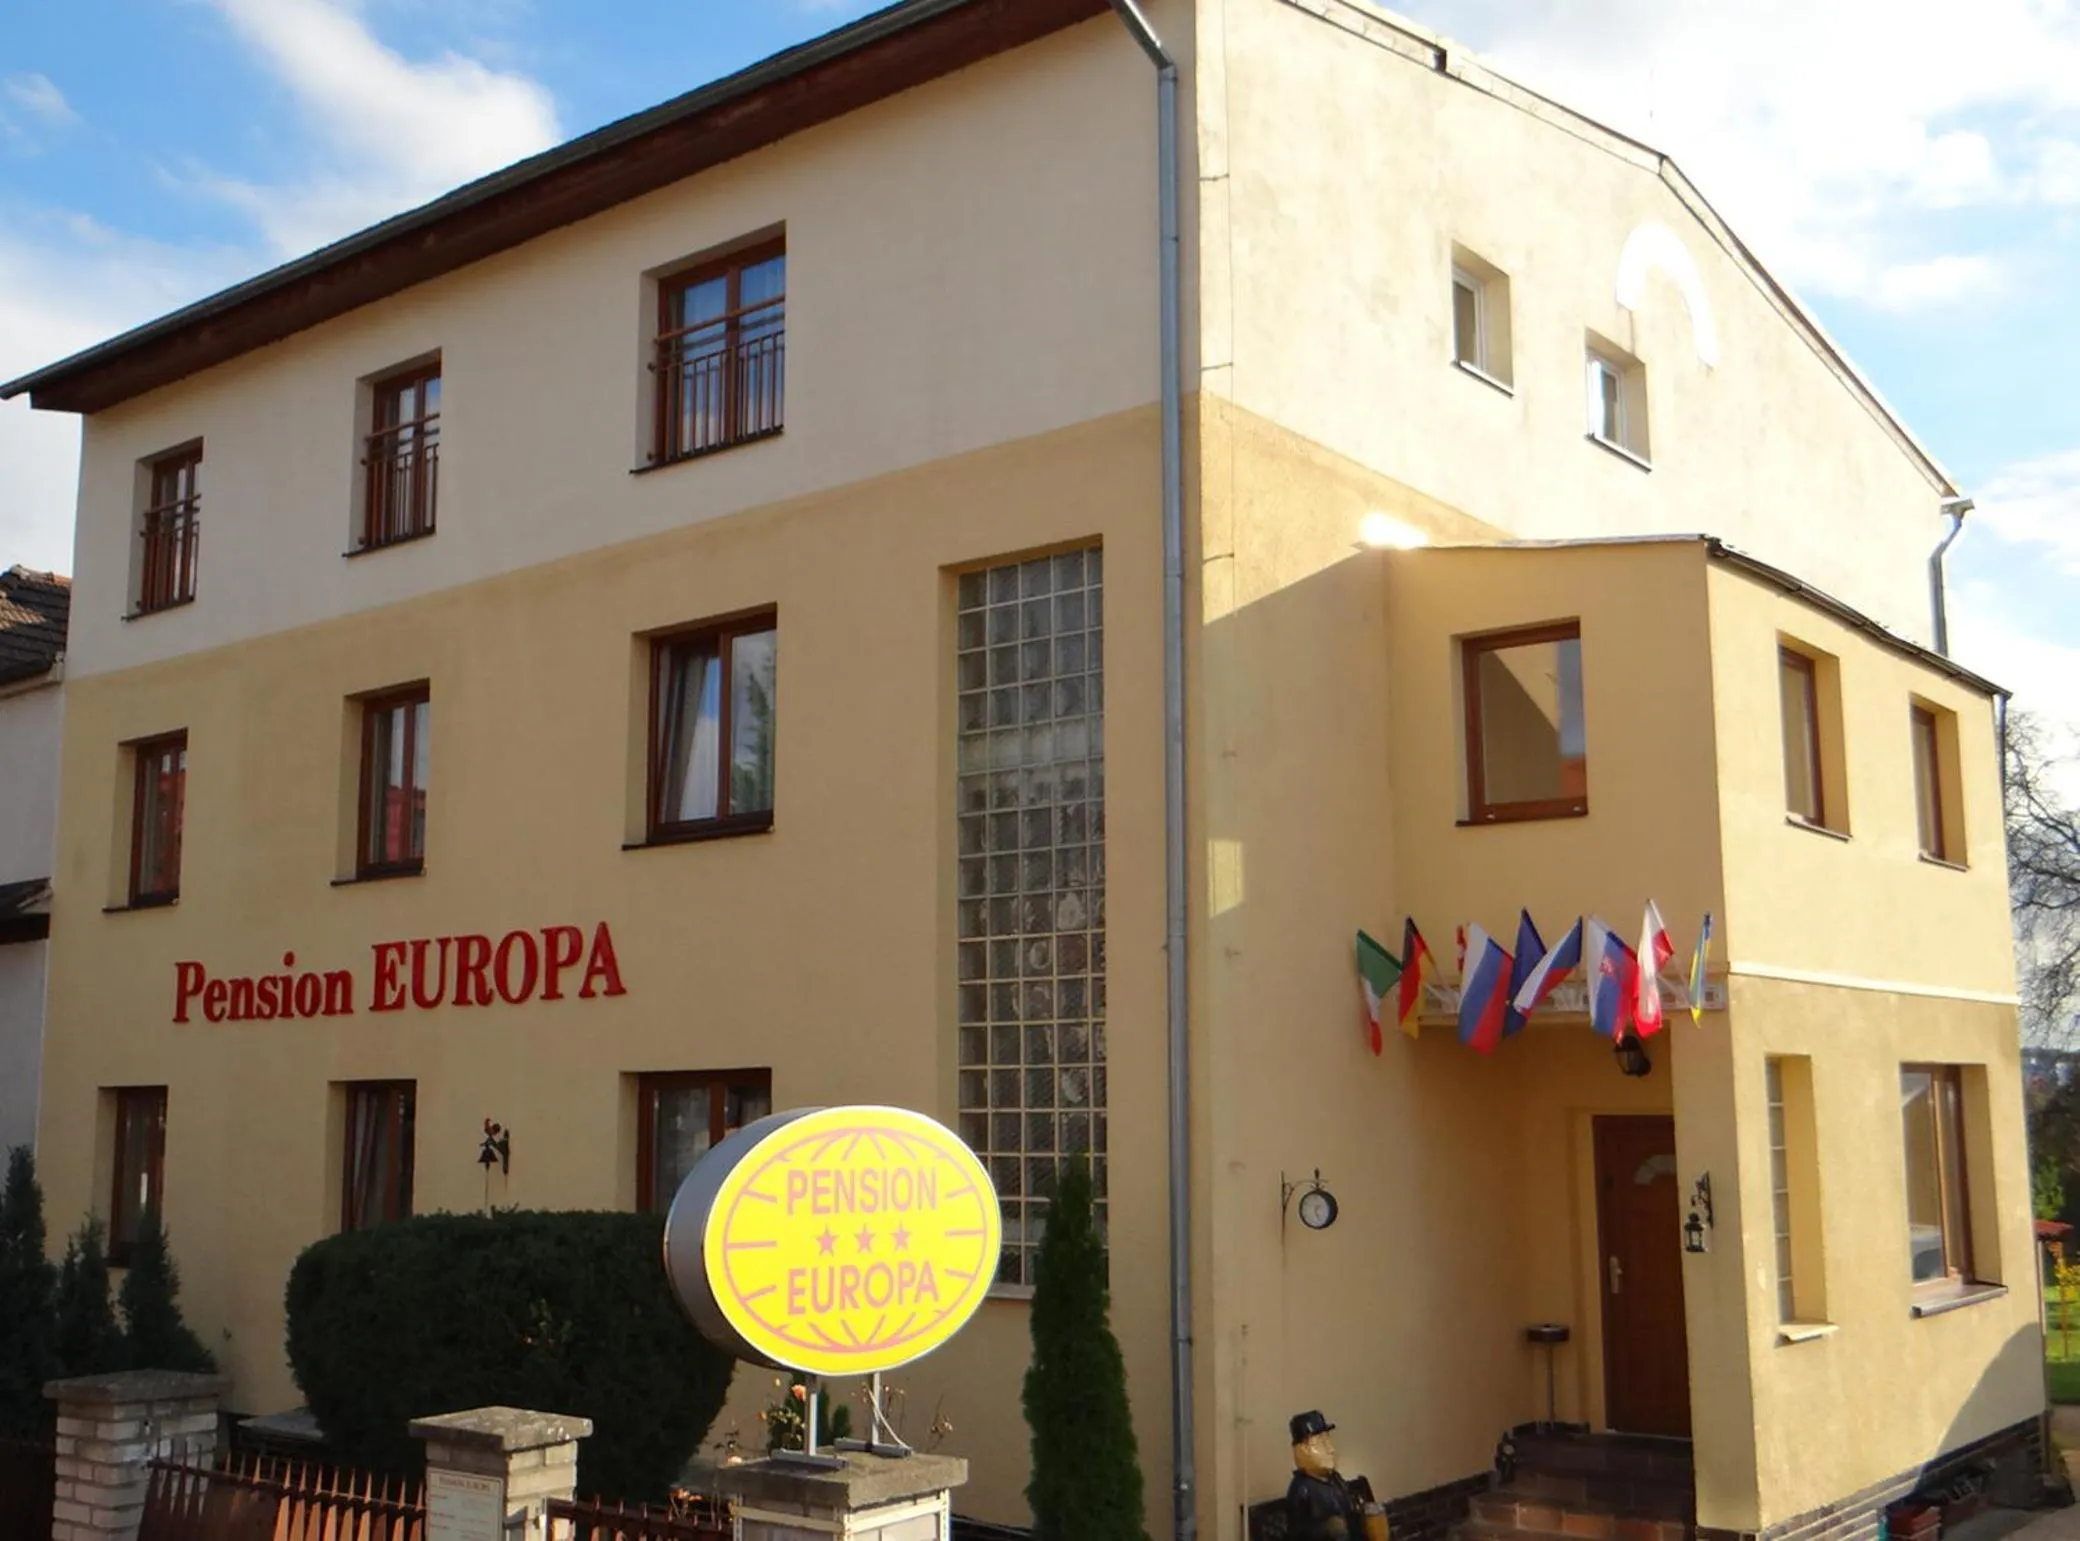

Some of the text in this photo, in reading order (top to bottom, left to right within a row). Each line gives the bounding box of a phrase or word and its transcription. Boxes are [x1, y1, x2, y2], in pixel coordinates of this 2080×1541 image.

[172, 921, 628, 1024] Pension EUROPA
[786, 1166, 939, 1216] PENSION
[786, 1260, 940, 1316] EUROPA
